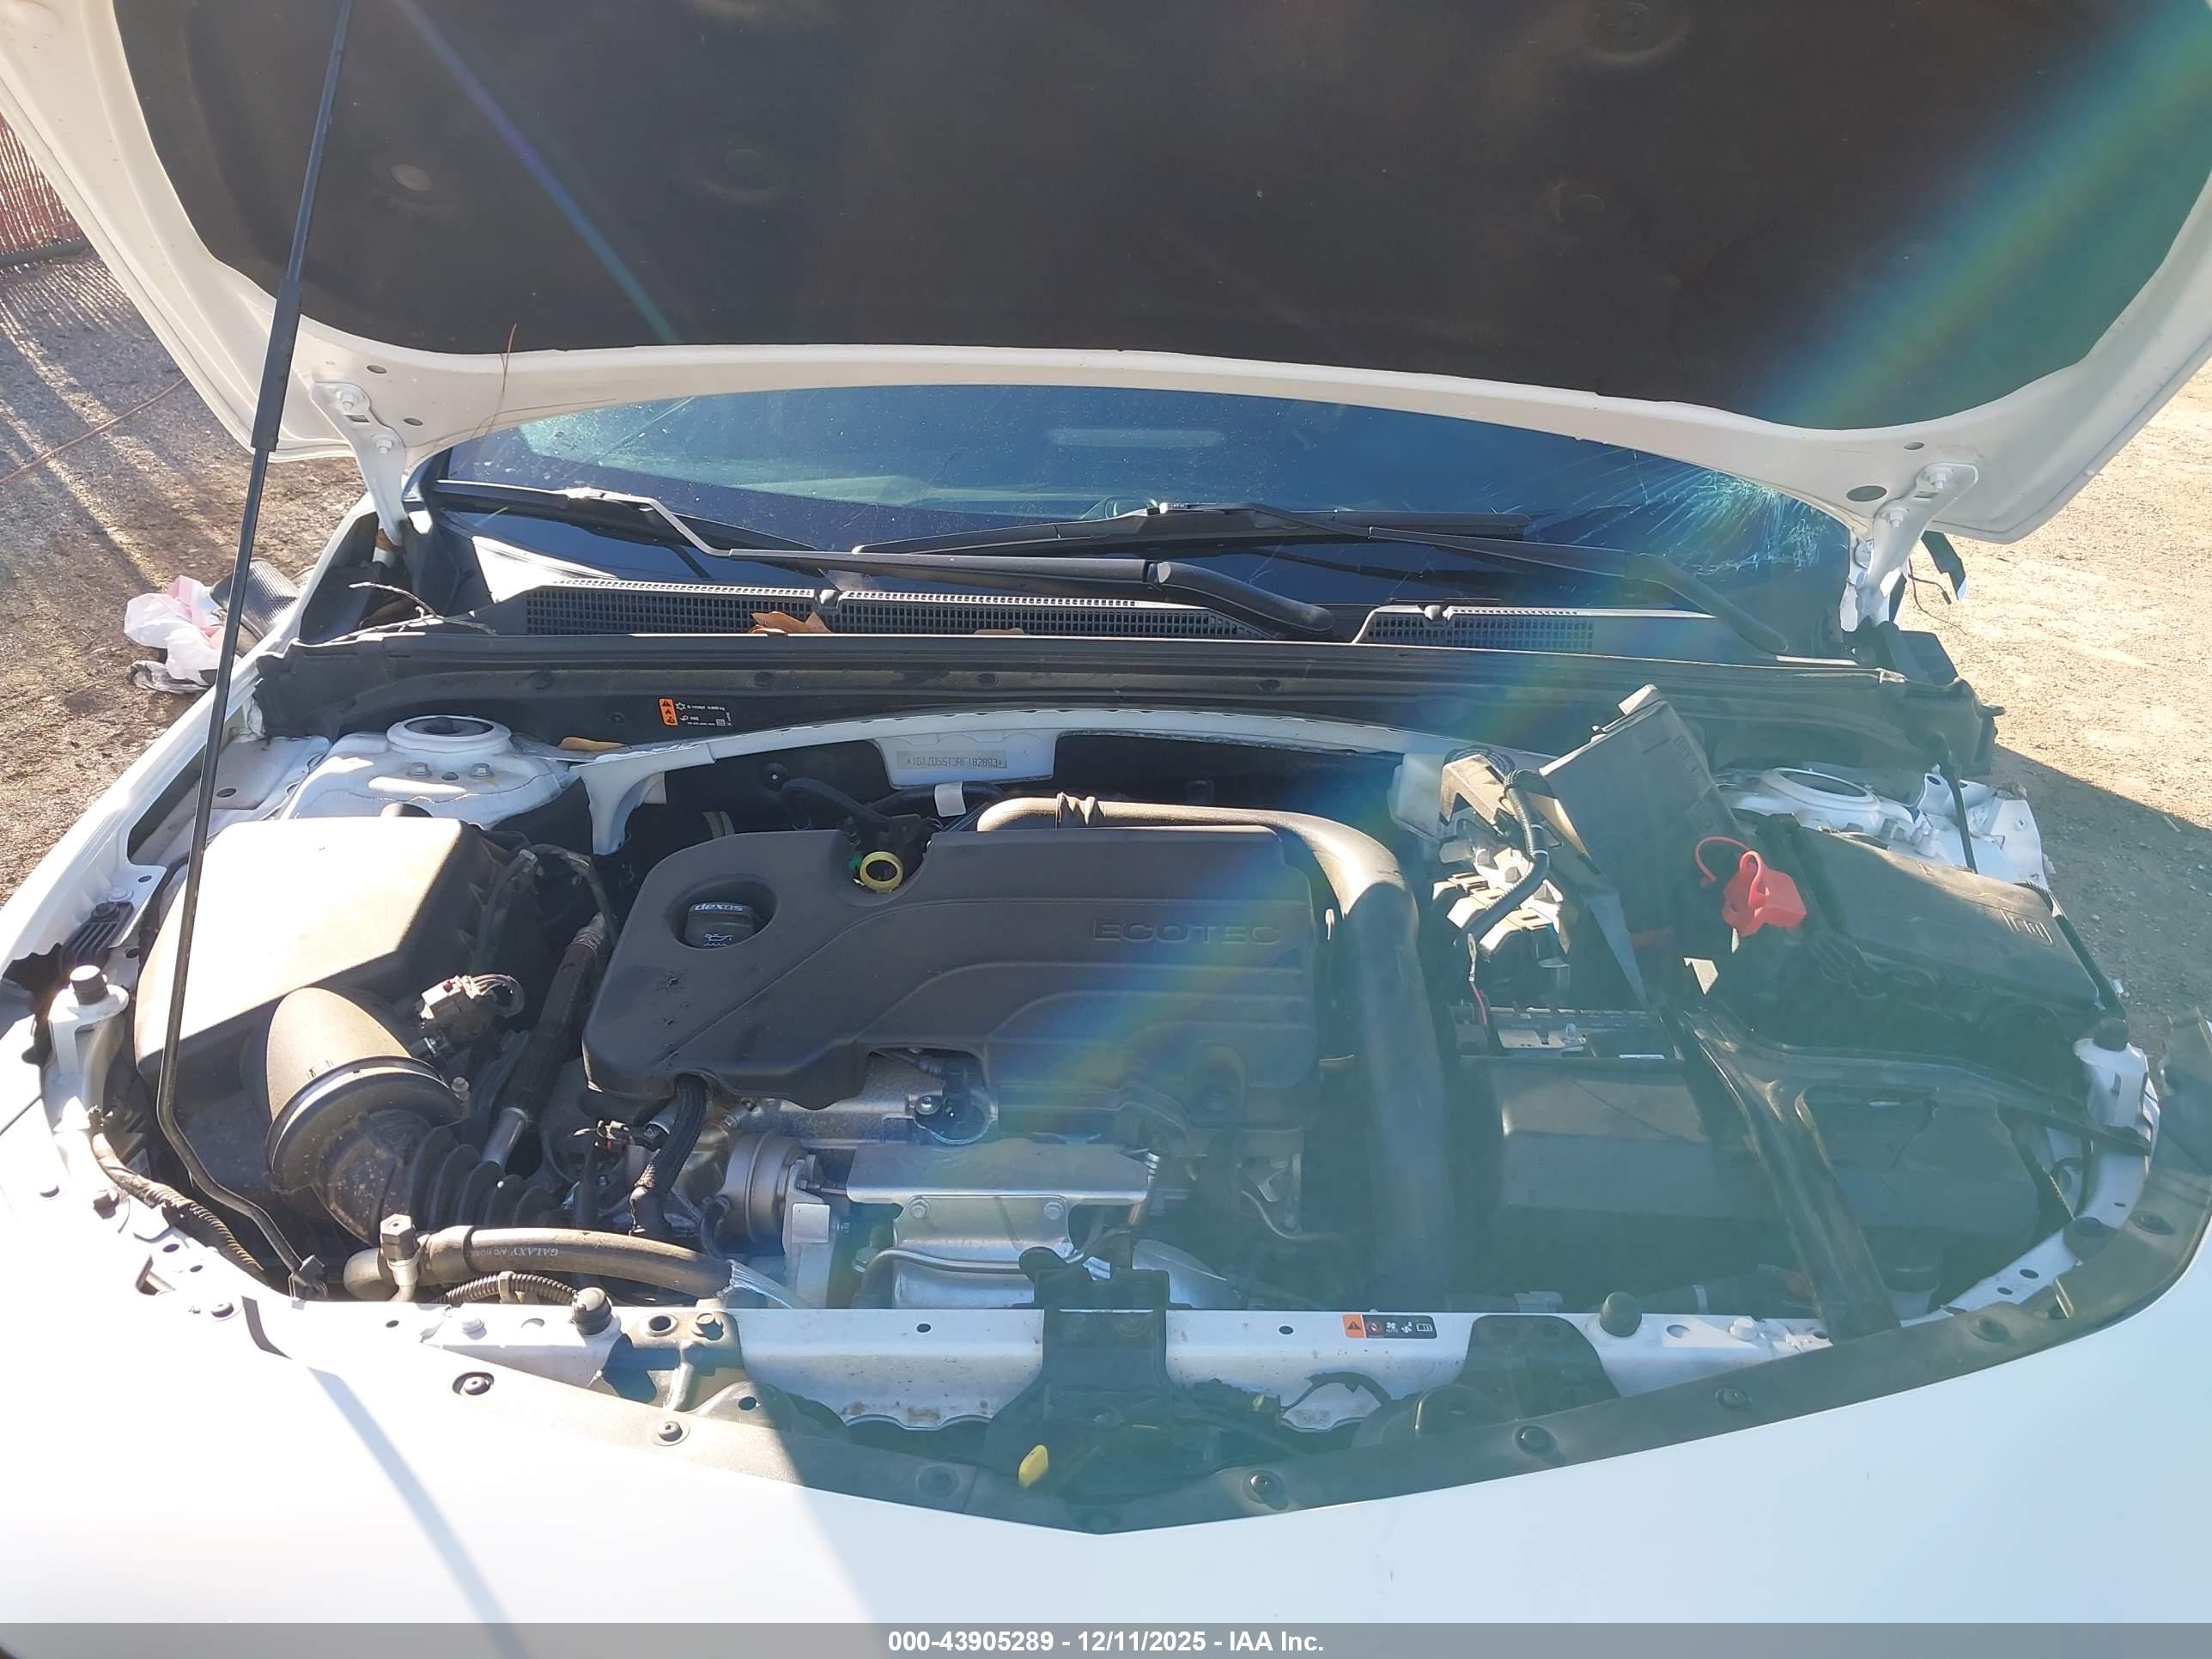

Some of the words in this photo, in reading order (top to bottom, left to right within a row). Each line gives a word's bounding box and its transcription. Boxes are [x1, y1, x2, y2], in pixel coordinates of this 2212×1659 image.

[694, 902, 743, 911] dexos
[1092, 920, 1282, 945] ECOTEC
[512, 1247, 559, 1257] GALAXY
